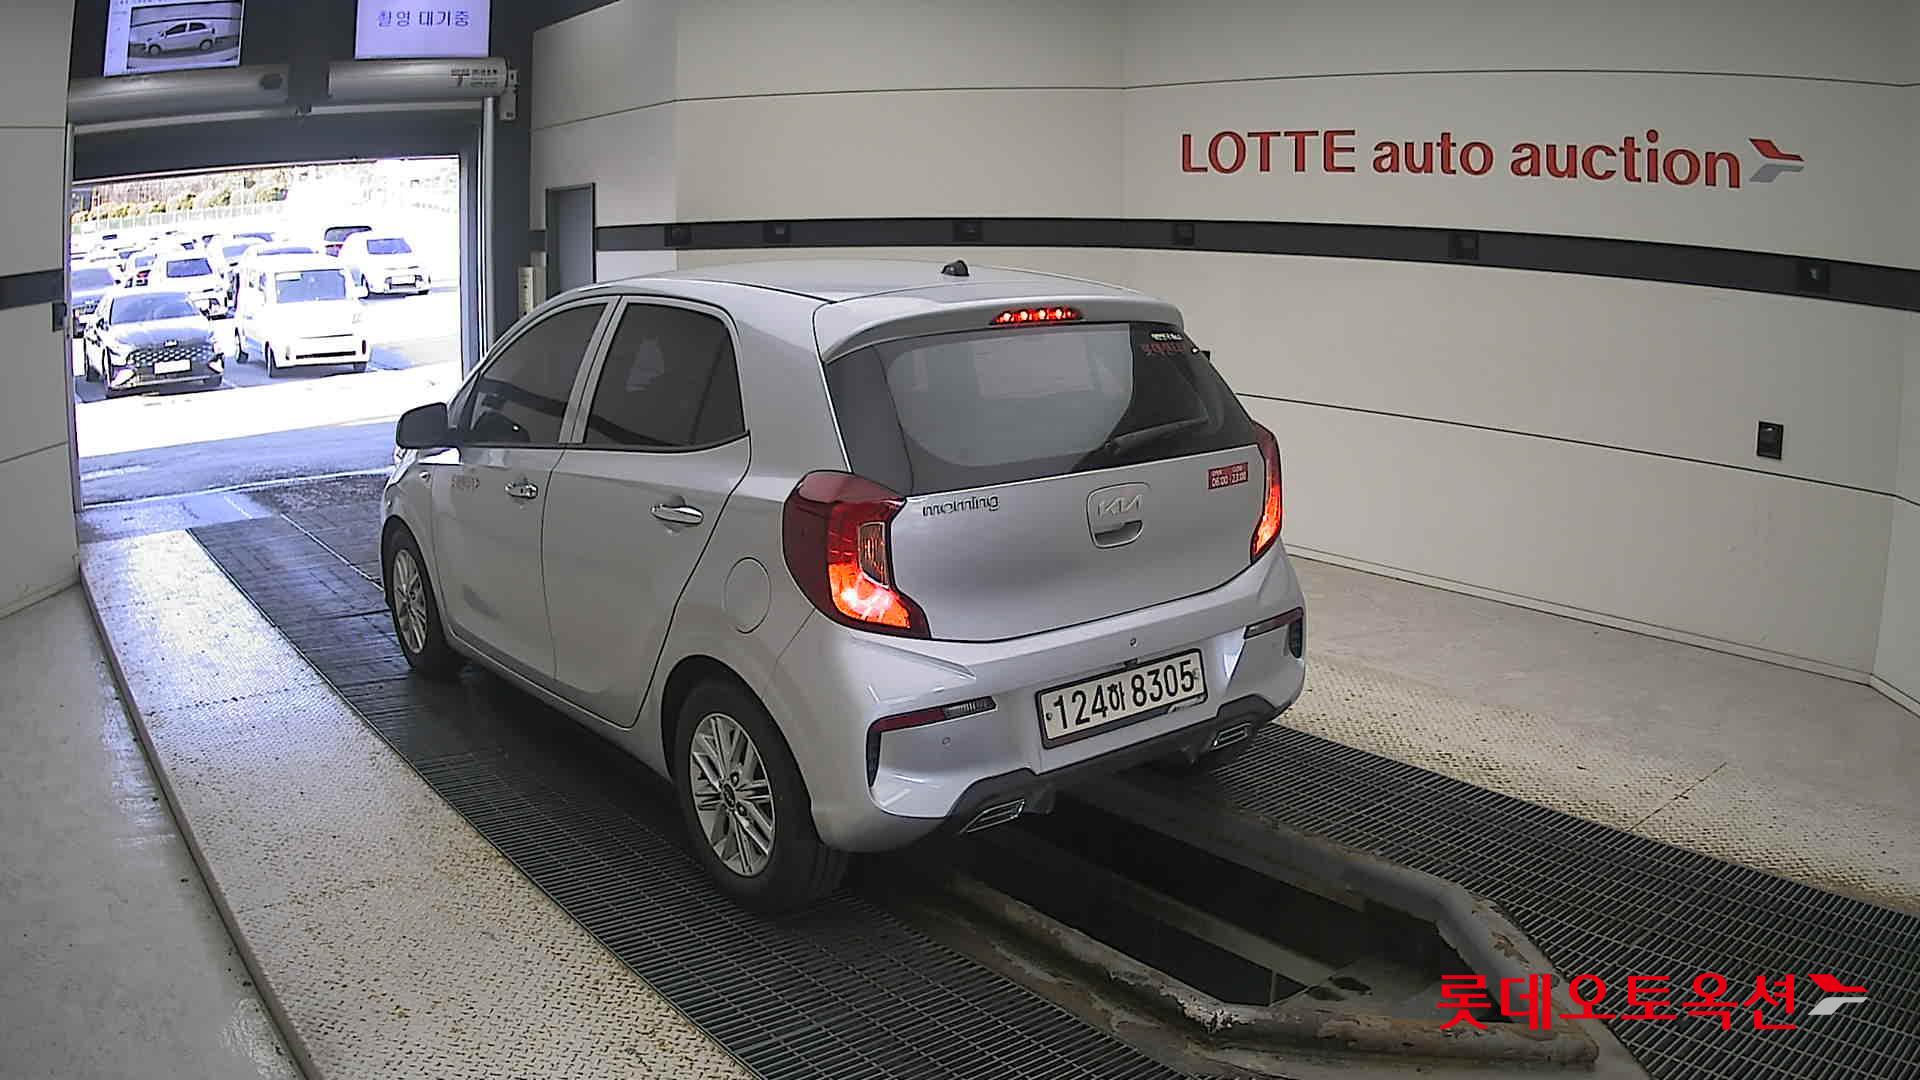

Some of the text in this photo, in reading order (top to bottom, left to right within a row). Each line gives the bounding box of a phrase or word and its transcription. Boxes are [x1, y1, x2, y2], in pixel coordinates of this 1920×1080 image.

[419, 10, 469, 27] 대기중
[1182, 129, 1742, 189] LOTTE auto auction
[922, 496, 999, 517] morning
[1054, 659, 1194, 729] 124하 8305
